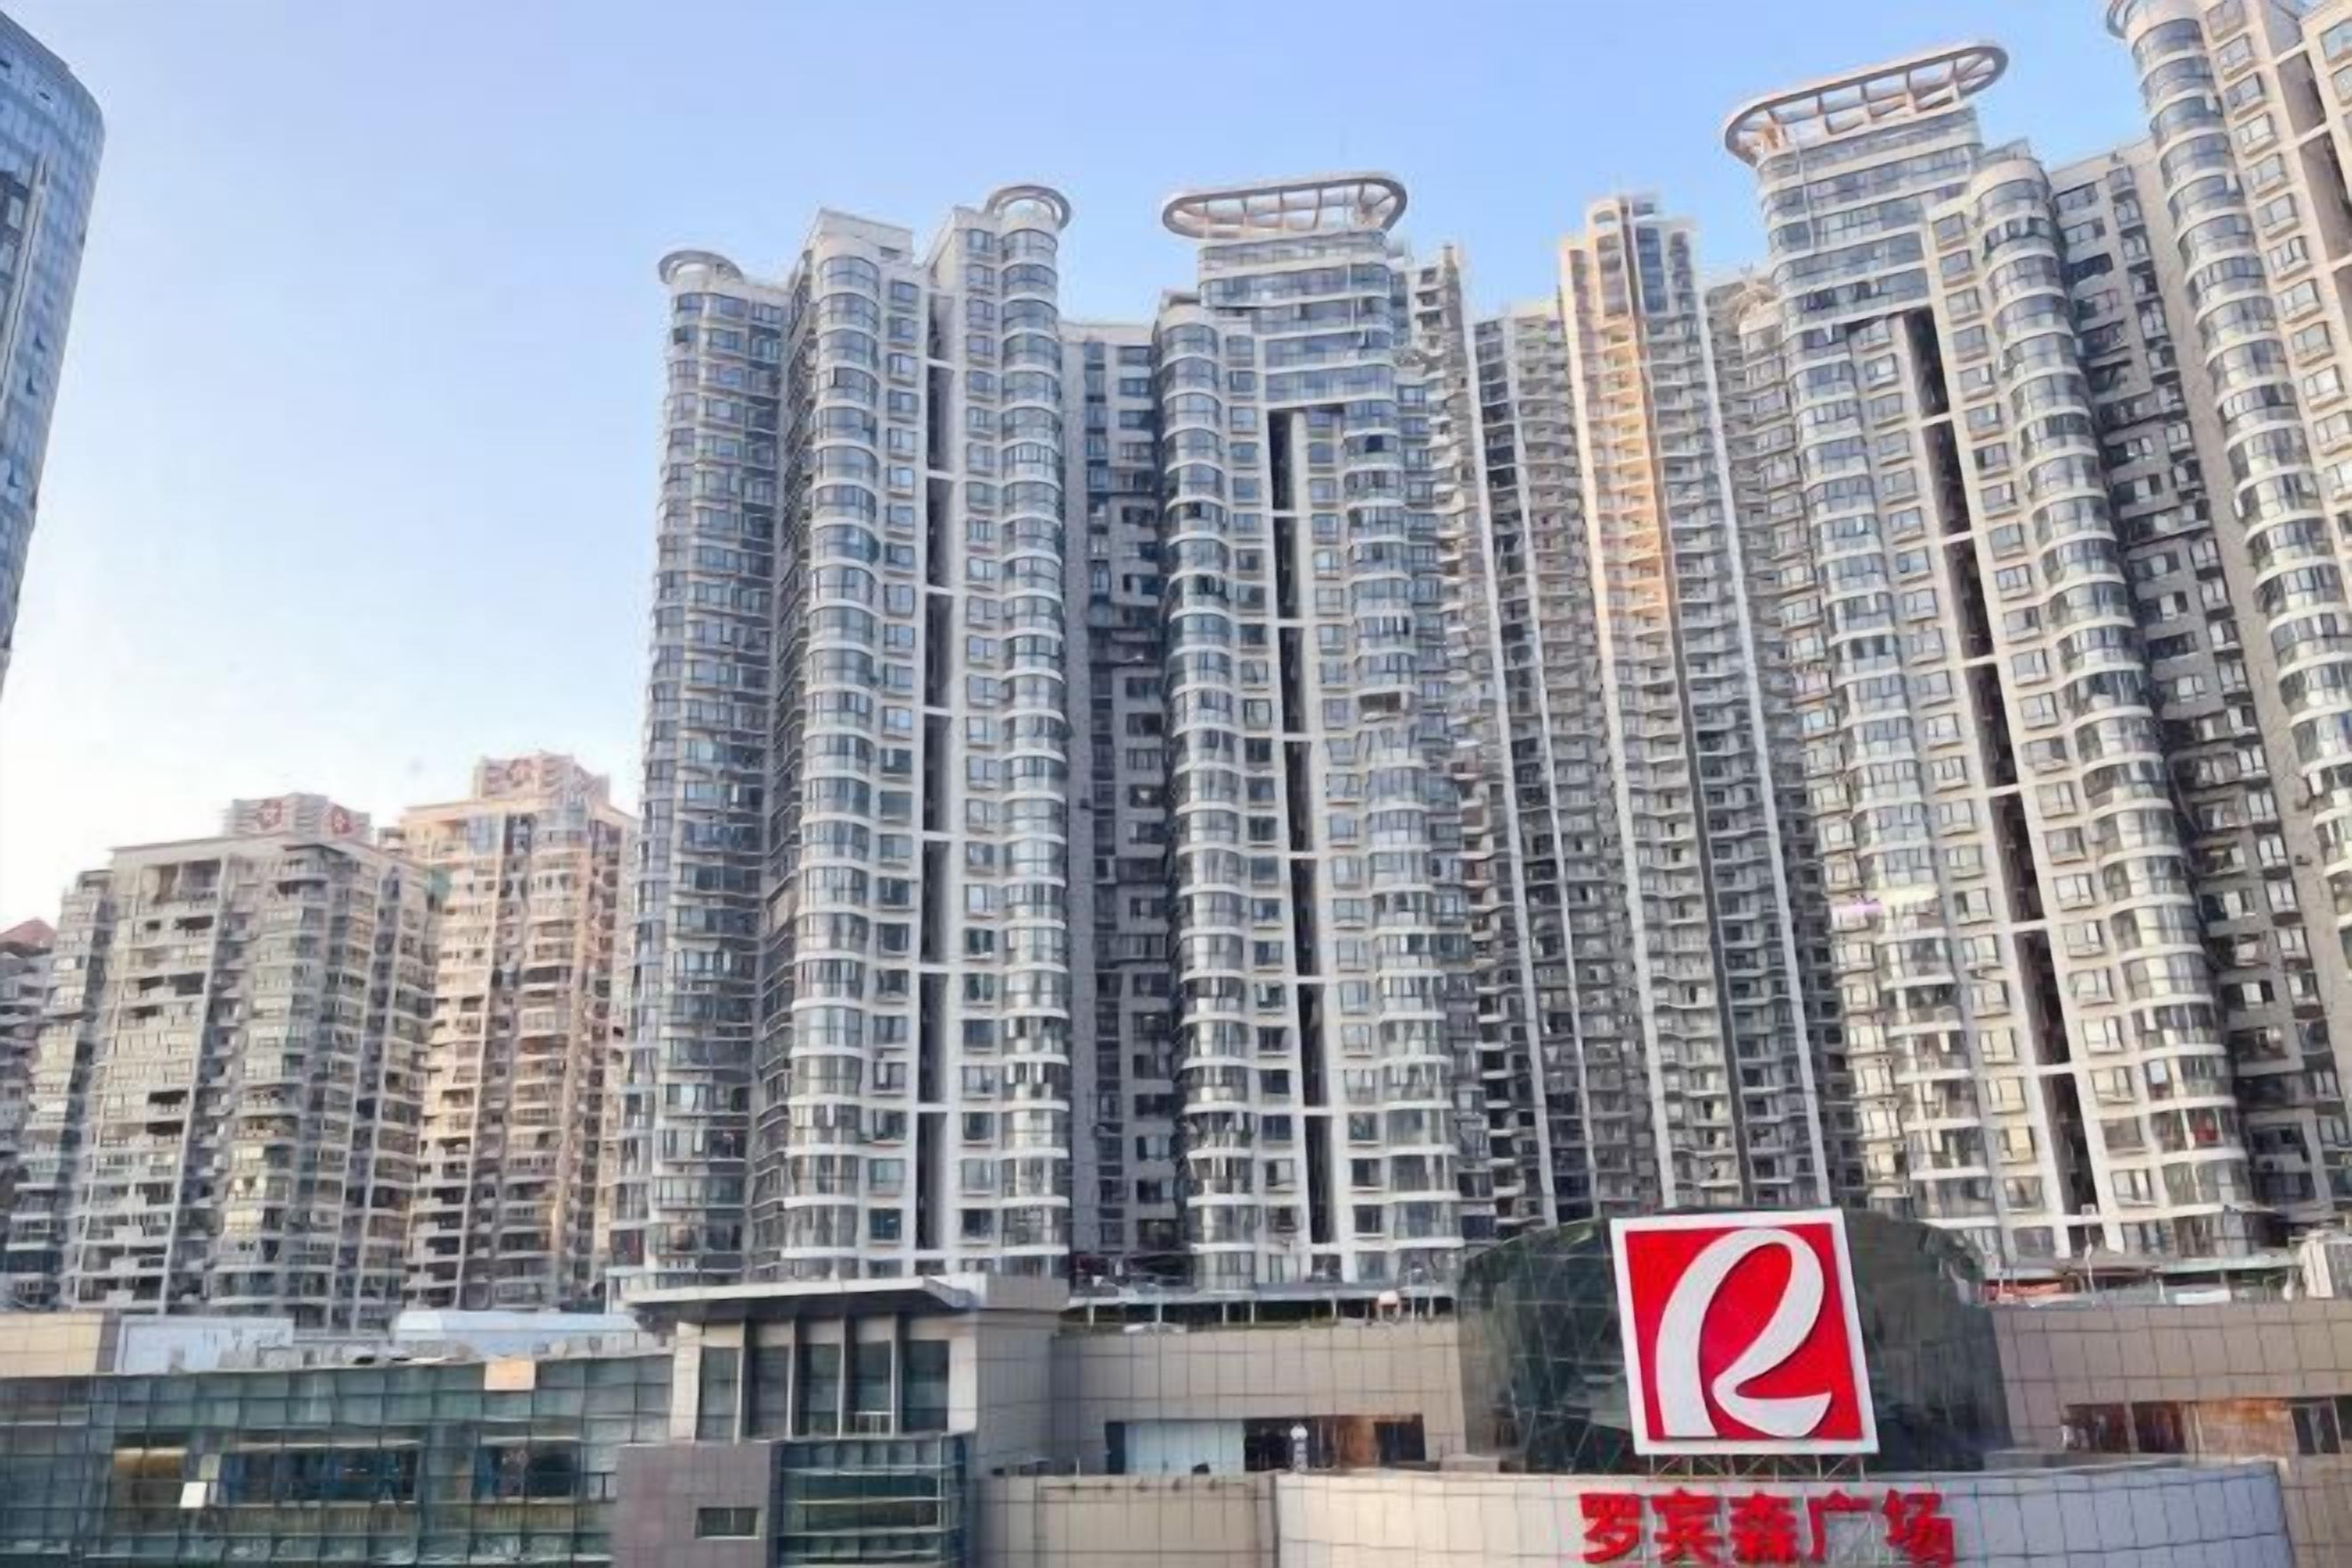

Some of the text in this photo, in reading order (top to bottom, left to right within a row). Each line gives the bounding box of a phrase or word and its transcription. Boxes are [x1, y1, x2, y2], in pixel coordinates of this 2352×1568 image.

[1579, 1489, 1955, 1568] 罗宾森广场
